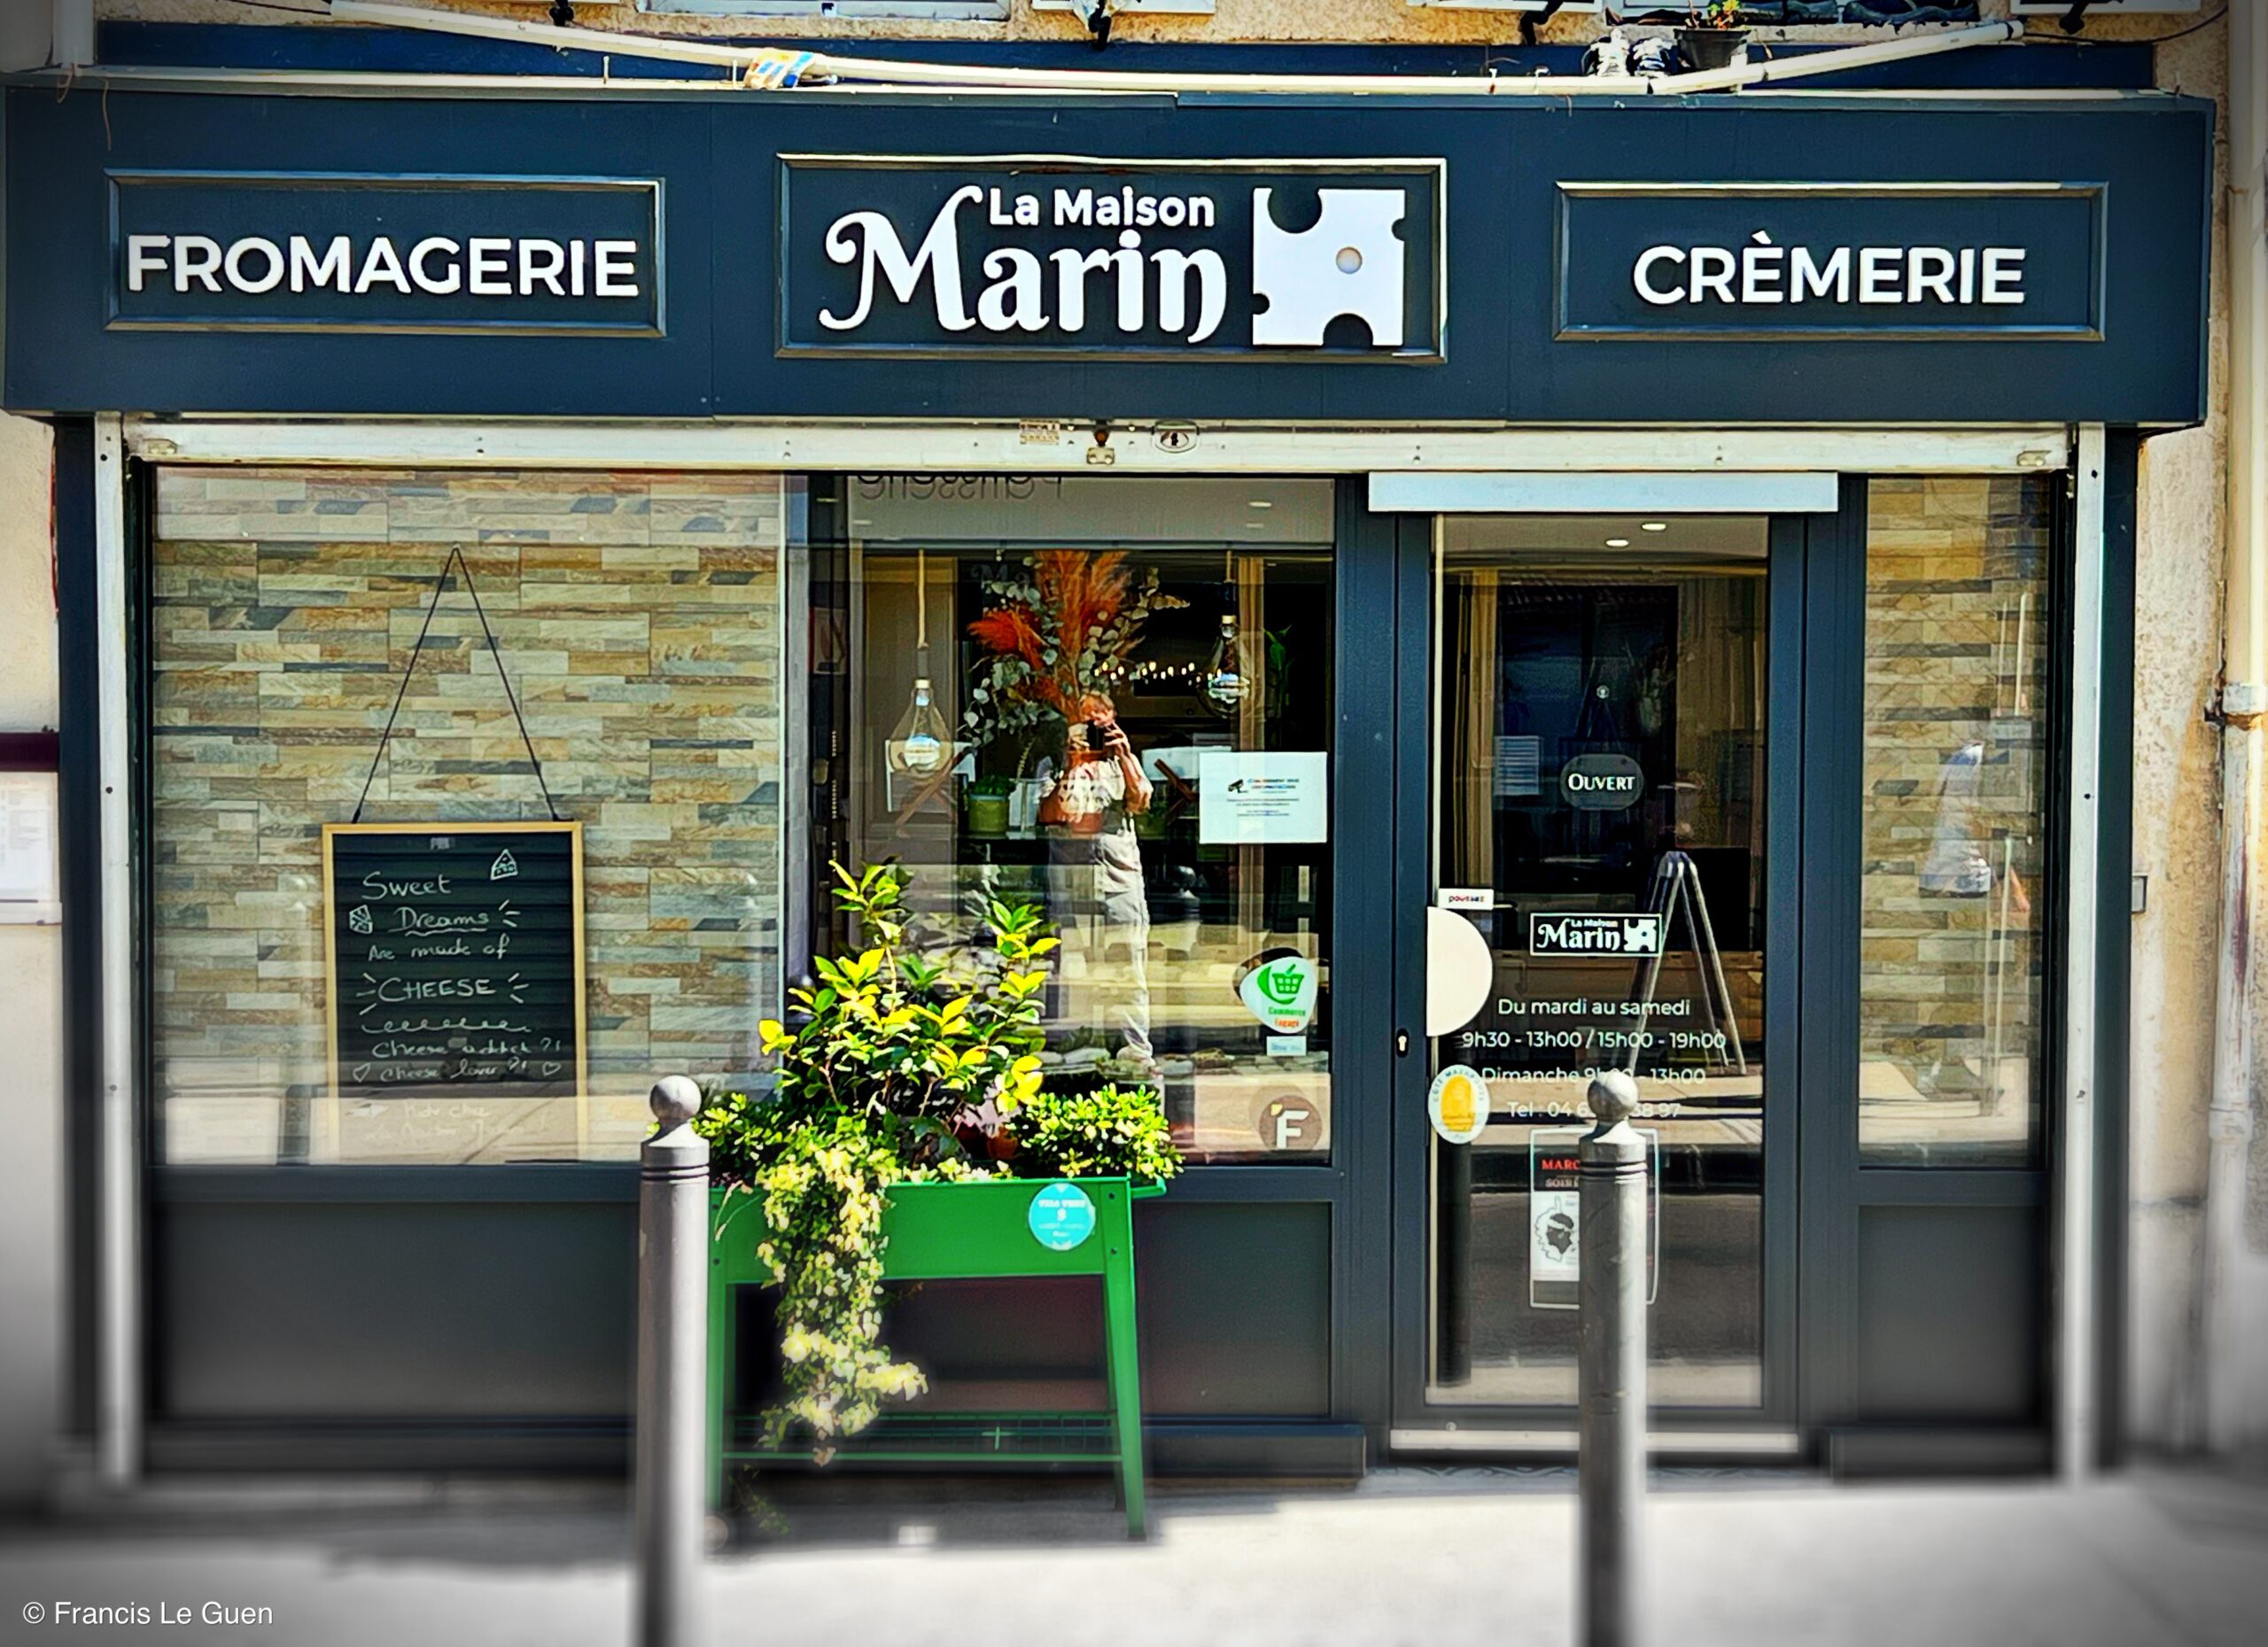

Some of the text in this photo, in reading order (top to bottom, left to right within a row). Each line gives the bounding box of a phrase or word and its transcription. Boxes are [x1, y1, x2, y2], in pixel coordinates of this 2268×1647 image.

[990, 185, 1215, 228] La Maison
[128, 235, 640, 297] FROMAGERIE
[819, 185, 1228, 344] Marin
[1633, 229, 2026, 305] CRÈMERIE
[361, 871, 452, 900] Sweet
[390, 906, 490, 930] Dreams
[411, 938, 470, 959] made
[483, 933, 510, 959] of
[1536, 918, 1620, 951] Marin
[378, 977, 496, 1002] CHEESE
[1498, 998, 1690, 1015] Du mardi au samedi
[1462, 1031, 1510, 1048] 9h30
[1526, 1030, 1582, 1048] 13h00
[1585, 1028, 1595, 1049] /
[1597, 1031, 1653, 1048] 15h00
[1669, 1031, 1726, 1049] 19h00
[1482, 1067, 1581, 1084] Dimanche
[1650, 1068, 1706, 1084] 13h00
[1508, 1101, 1534, 1117] Tel
[1548, 1102, 1571, 1117] 04
[1577, 1102, 1596, 1117] 6
